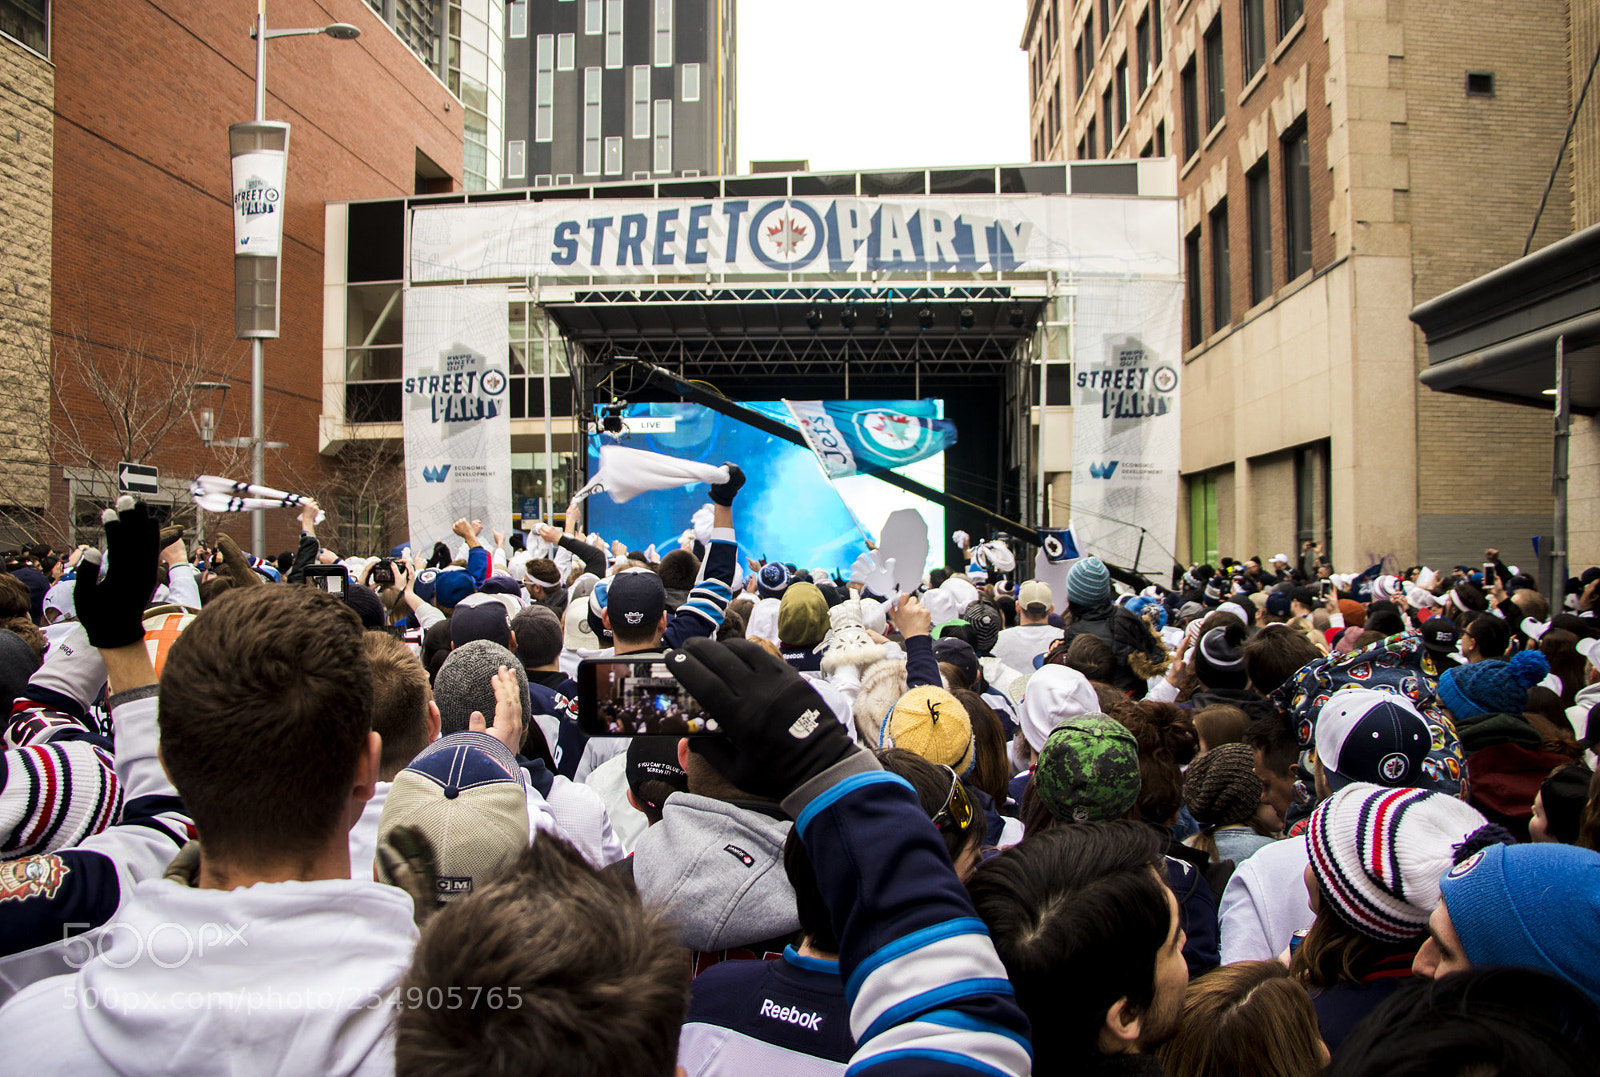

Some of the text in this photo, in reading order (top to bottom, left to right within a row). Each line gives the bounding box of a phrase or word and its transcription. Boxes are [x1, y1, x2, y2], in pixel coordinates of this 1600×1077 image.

[235, 189, 263, 203] STREET
[551, 199, 1034, 272] STREET PARTY
[405, 371, 477, 393] STREET
[1077, 368, 1149, 390] STREET
[432, 392, 503, 423] PARTY
[1102, 388, 1174, 419] PARTY
[641, 421, 661, 429] LIVE
[813, 415, 847, 465] Jets
[650, 761, 666, 769] CAN'T
[666, 764, 680, 773] GLUE
[760, 998, 823, 1031] Reebok
